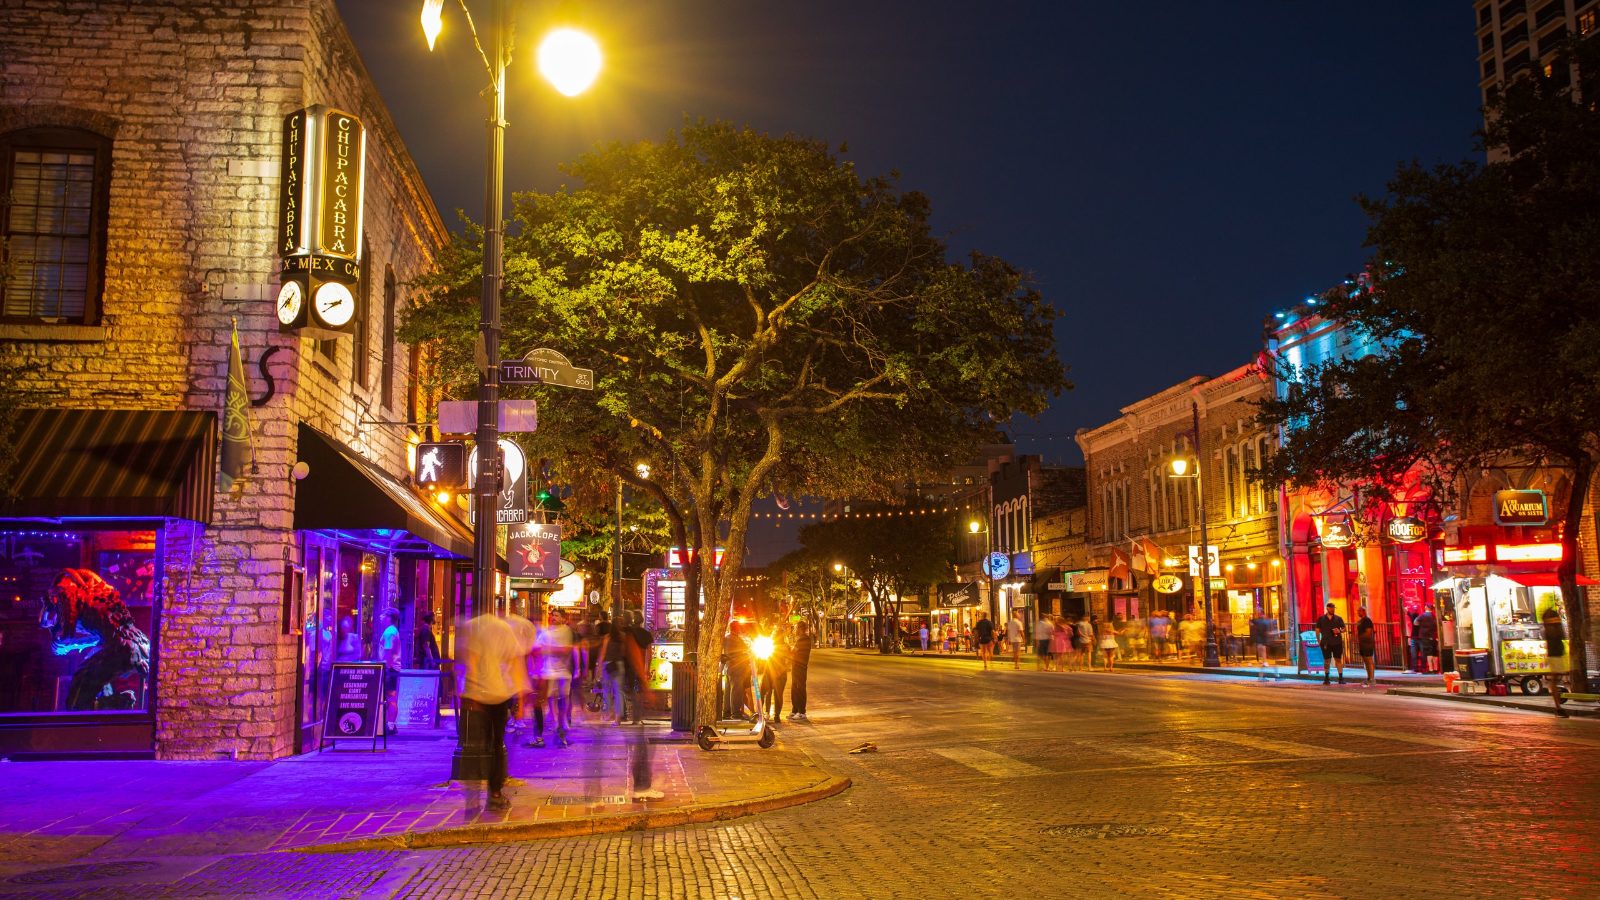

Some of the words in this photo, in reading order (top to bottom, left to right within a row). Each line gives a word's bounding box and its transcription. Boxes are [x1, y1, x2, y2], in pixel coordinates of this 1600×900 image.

[285, 115, 299, 251] CHUPACABRA
[331, 118, 350, 252] CHUPACABRA
[503, 366, 559, 380] TRINITY
[1500, 500, 1544, 517] AQUARIUM
[509, 531, 559, 541] JACKALOPE
[1389, 523, 1425, 536] ROOFTOP
